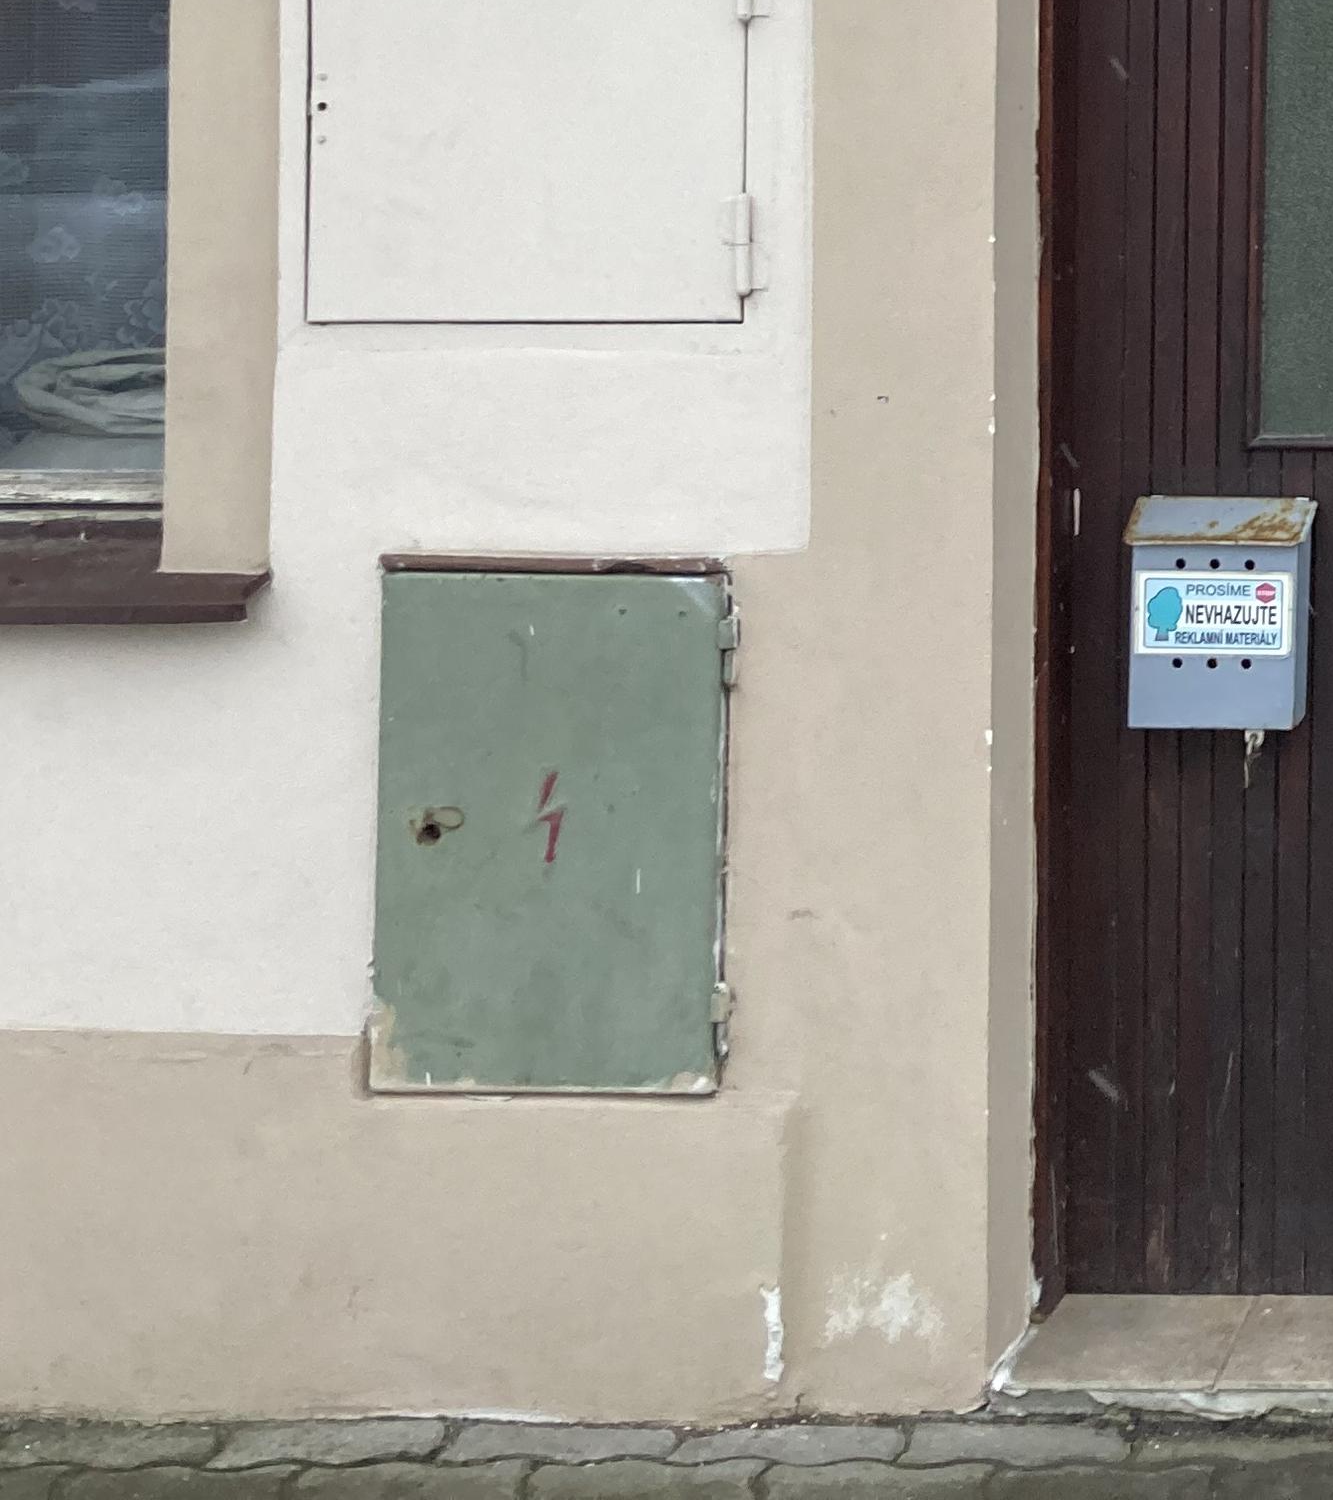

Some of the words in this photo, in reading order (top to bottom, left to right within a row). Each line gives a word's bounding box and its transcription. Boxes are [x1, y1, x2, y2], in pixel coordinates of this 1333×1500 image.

[1185, 582, 1252, 597] PROSÍME
[1185, 603, 1278, 625] NEVHAZUJTE
[1174, 629, 1224, 645] REKLAMNÍ
[1225, 630, 1278, 646] MATERIÁLY
